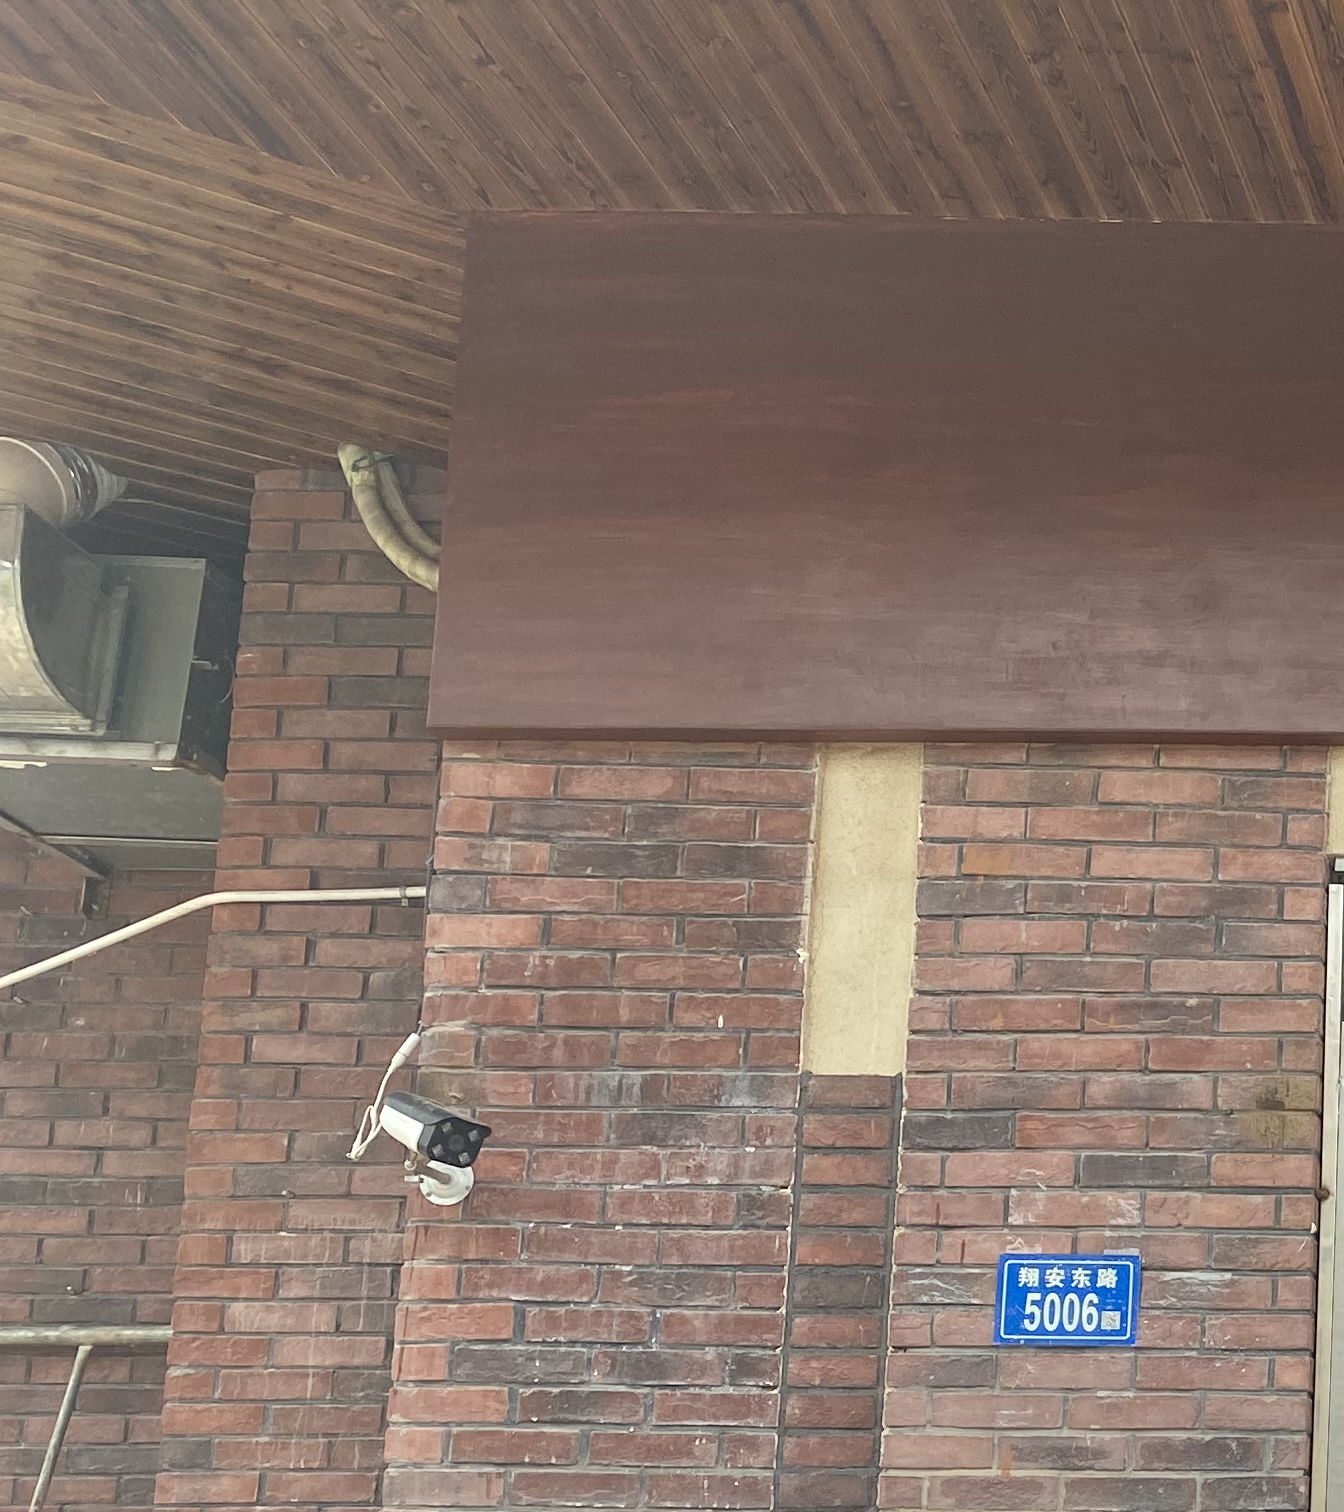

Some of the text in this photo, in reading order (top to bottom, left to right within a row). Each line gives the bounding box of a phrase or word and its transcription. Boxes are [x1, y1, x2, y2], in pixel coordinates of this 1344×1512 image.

[1017, 1266, 1119, 1289] 翔安东路
[1023, 1292, 1099, 1332] 5006
